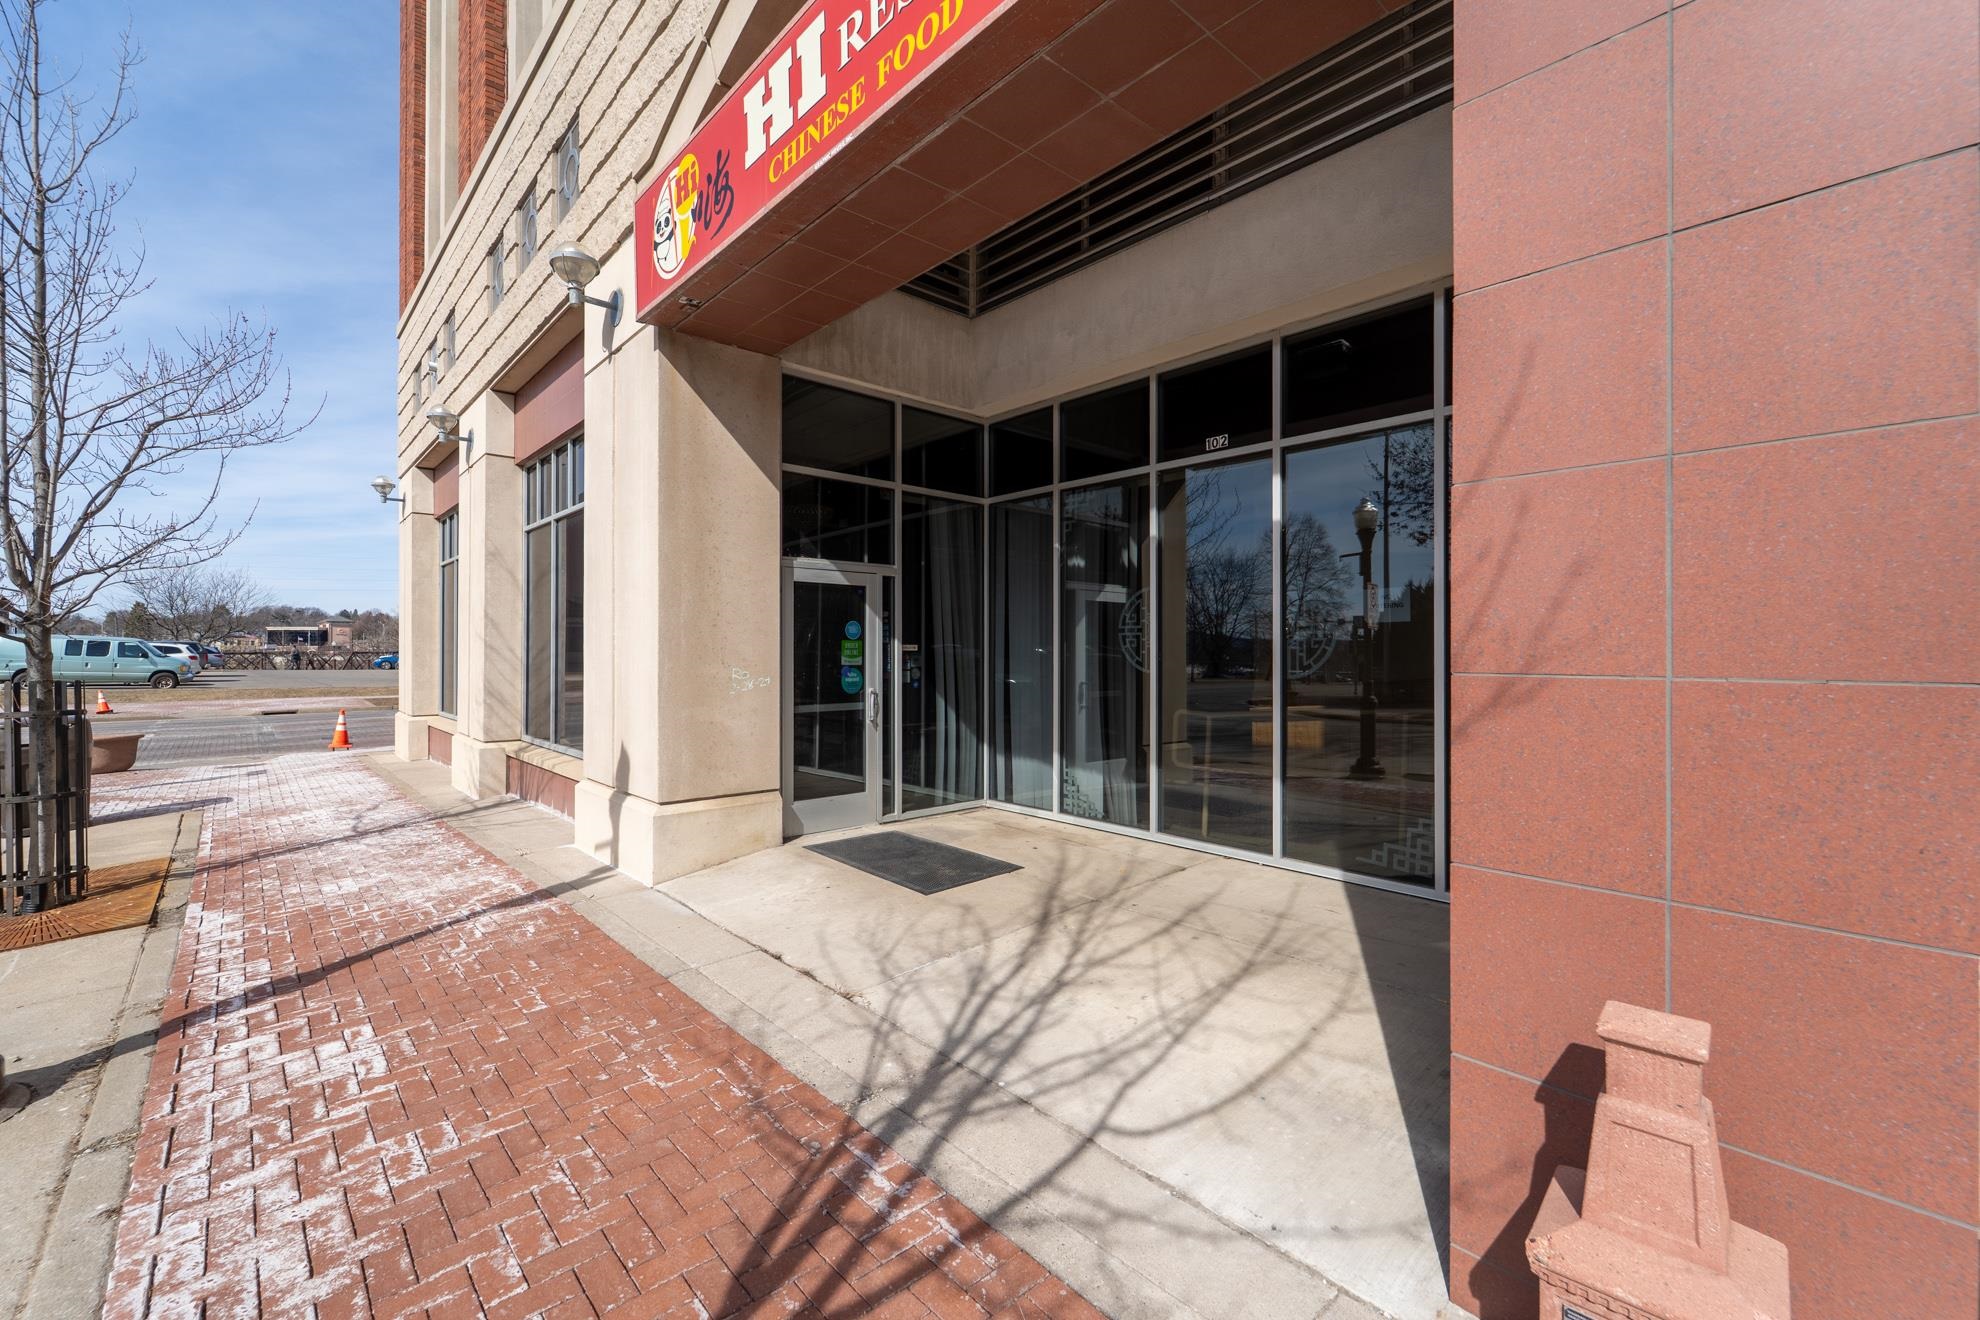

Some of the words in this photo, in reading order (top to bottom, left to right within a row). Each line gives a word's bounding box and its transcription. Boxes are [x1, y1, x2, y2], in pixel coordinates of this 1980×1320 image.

[743, 10, 827, 170] HI
[768, 76, 866, 184] CHINESE
[876, 0, 964, 92] FOOD
[1206, 434, 1228, 450] 102
